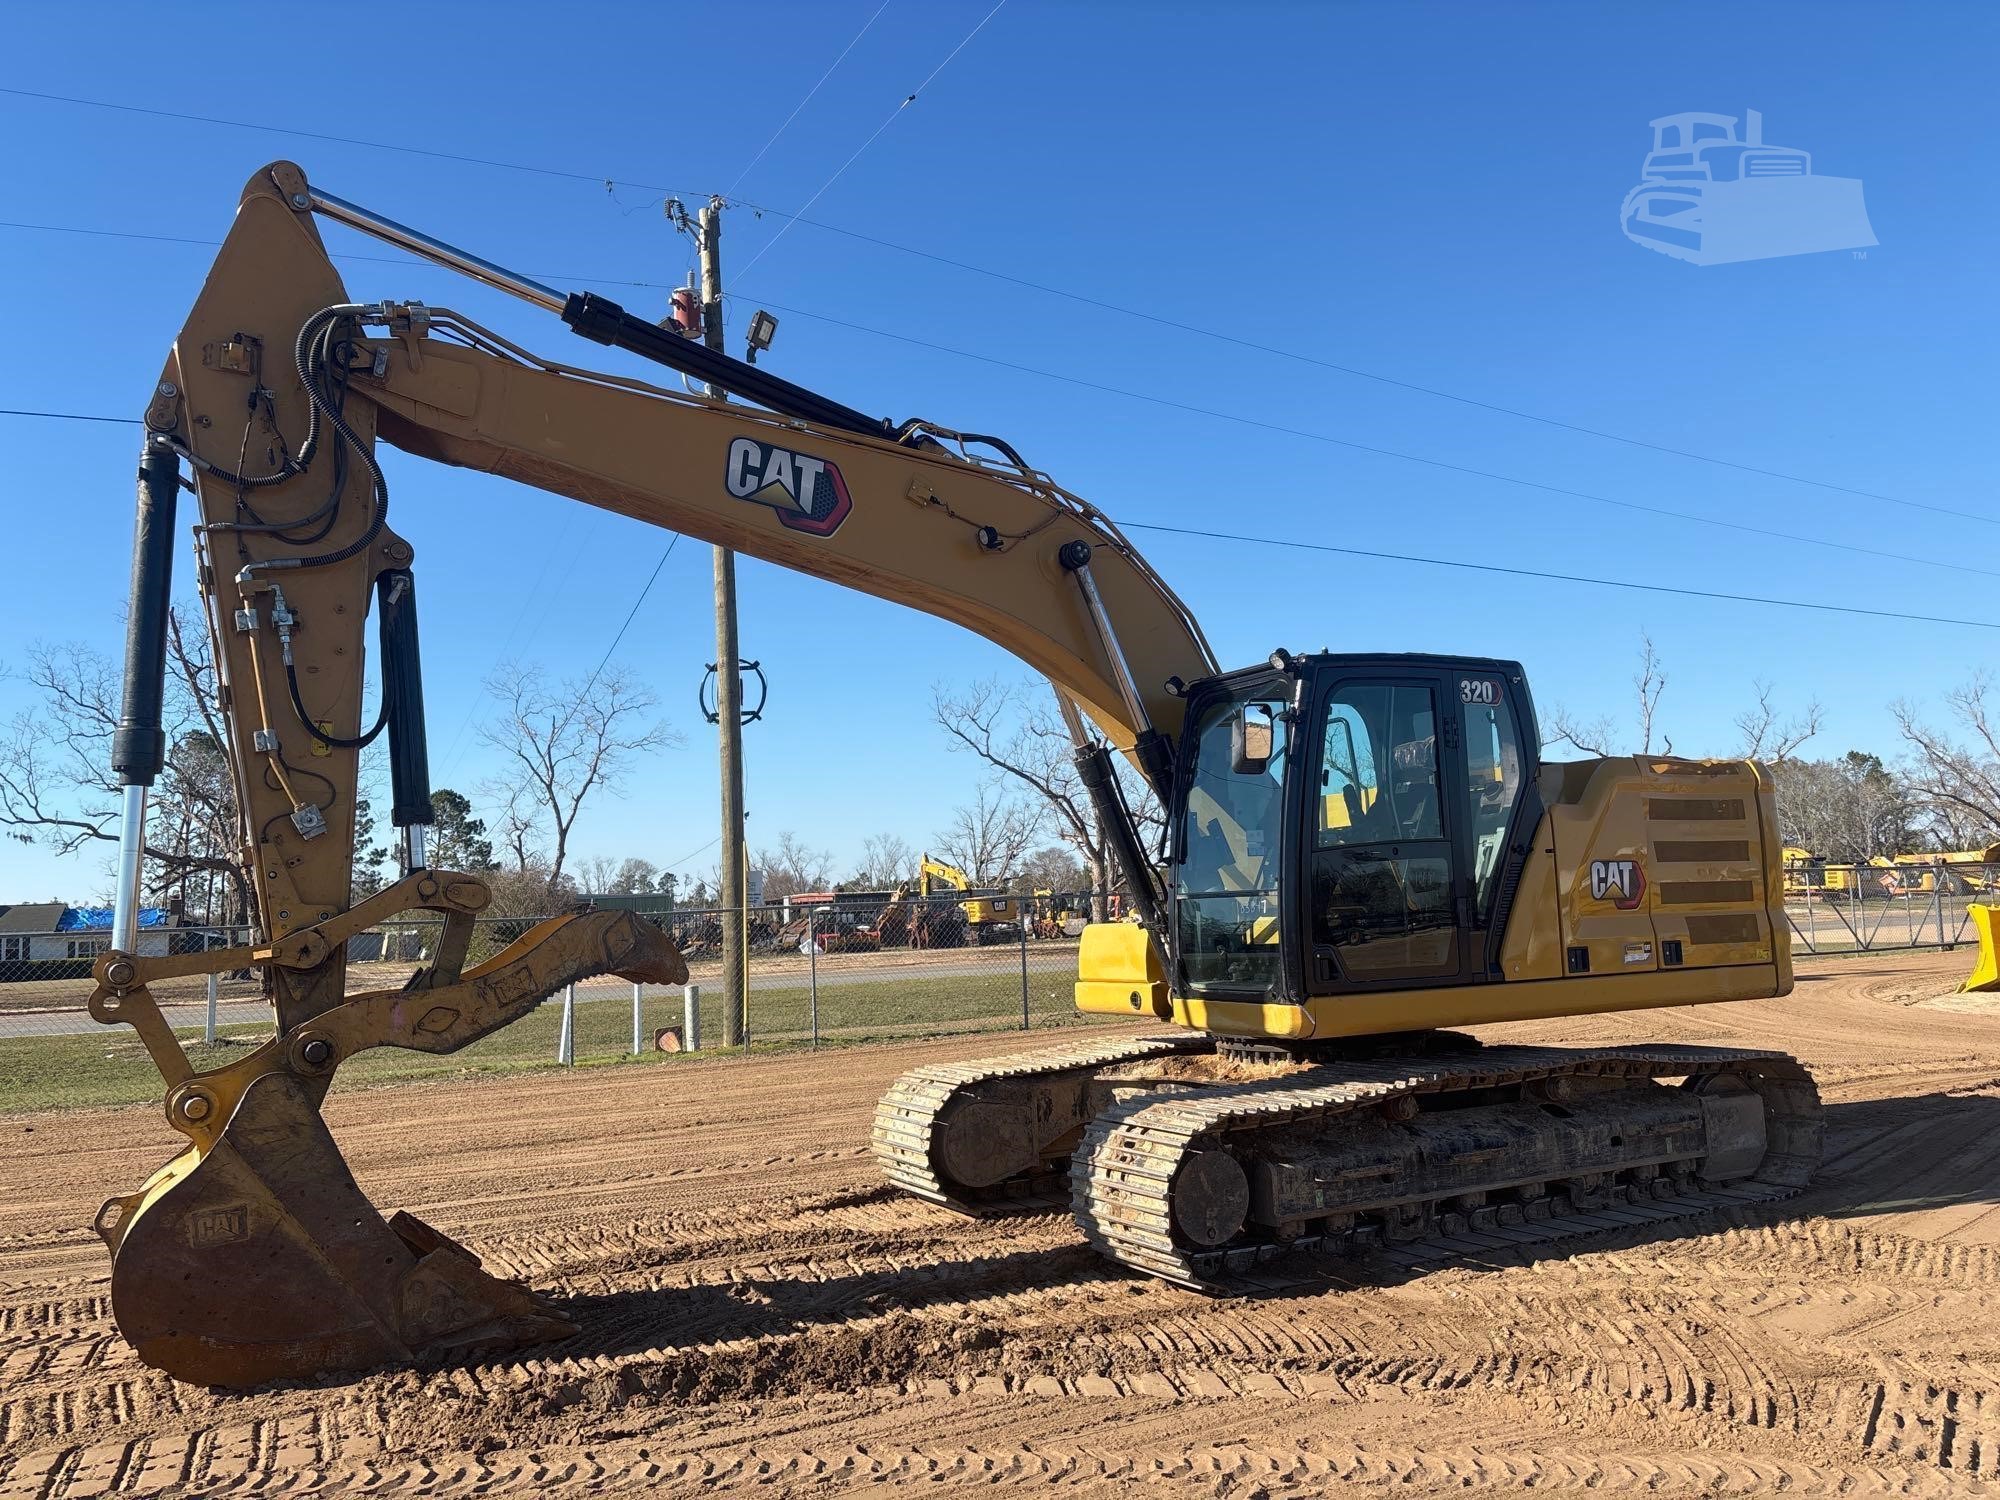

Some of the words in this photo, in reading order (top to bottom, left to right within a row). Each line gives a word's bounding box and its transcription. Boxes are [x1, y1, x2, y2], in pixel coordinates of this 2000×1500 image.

[727, 438, 825, 515] CAT
[1460, 680, 1493, 703] 320
[1591, 861, 1633, 899] CAT
[994, 901, 1006, 911] CAT
[196, 1210, 243, 1242] CAT
